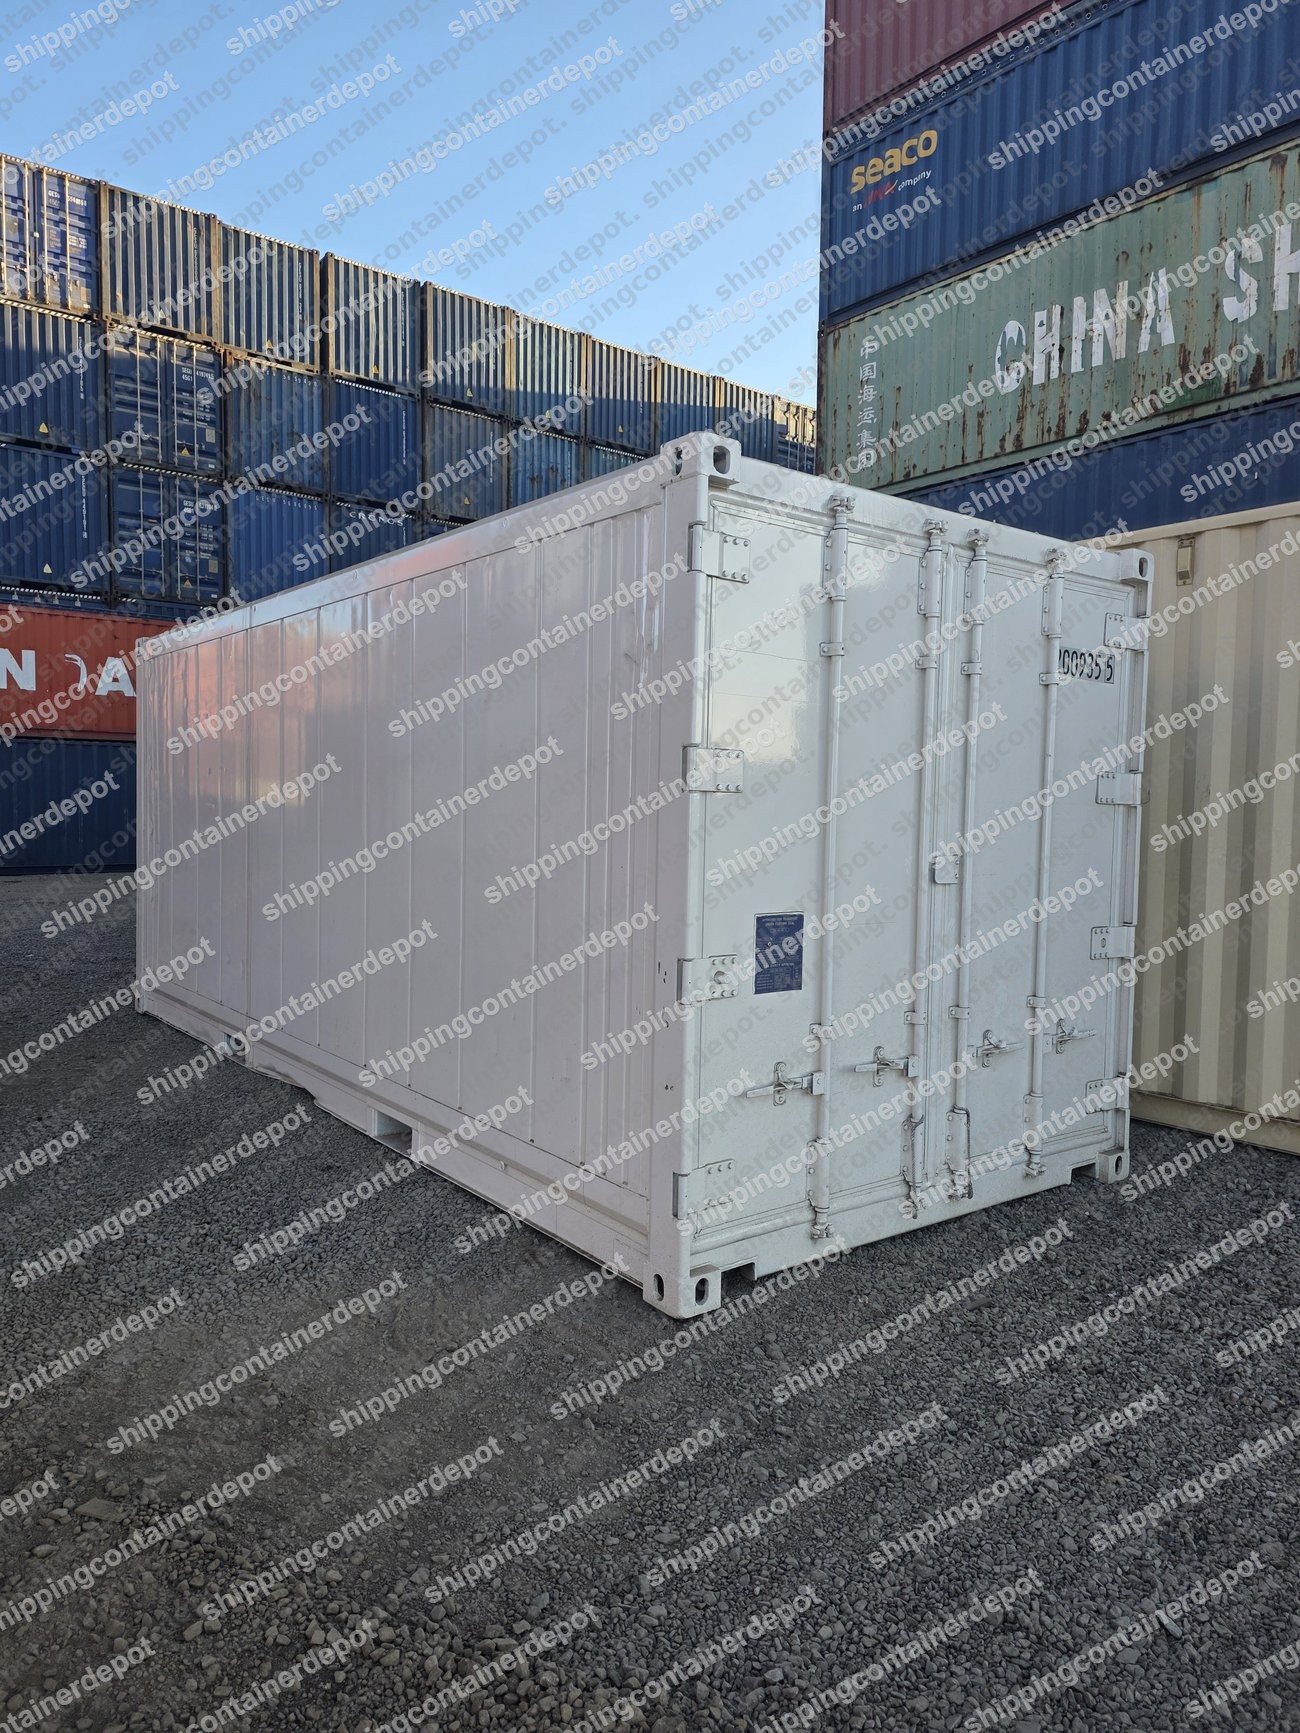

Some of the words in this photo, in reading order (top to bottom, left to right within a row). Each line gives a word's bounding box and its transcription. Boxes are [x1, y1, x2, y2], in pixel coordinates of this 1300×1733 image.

[850, 130, 938, 195] seaco
[852, 203, 863, 212] an
[898, 170, 931, 191] company
[995, 267, 1176, 394] CHINA
[1059, 649, 1102, 680] 00935
